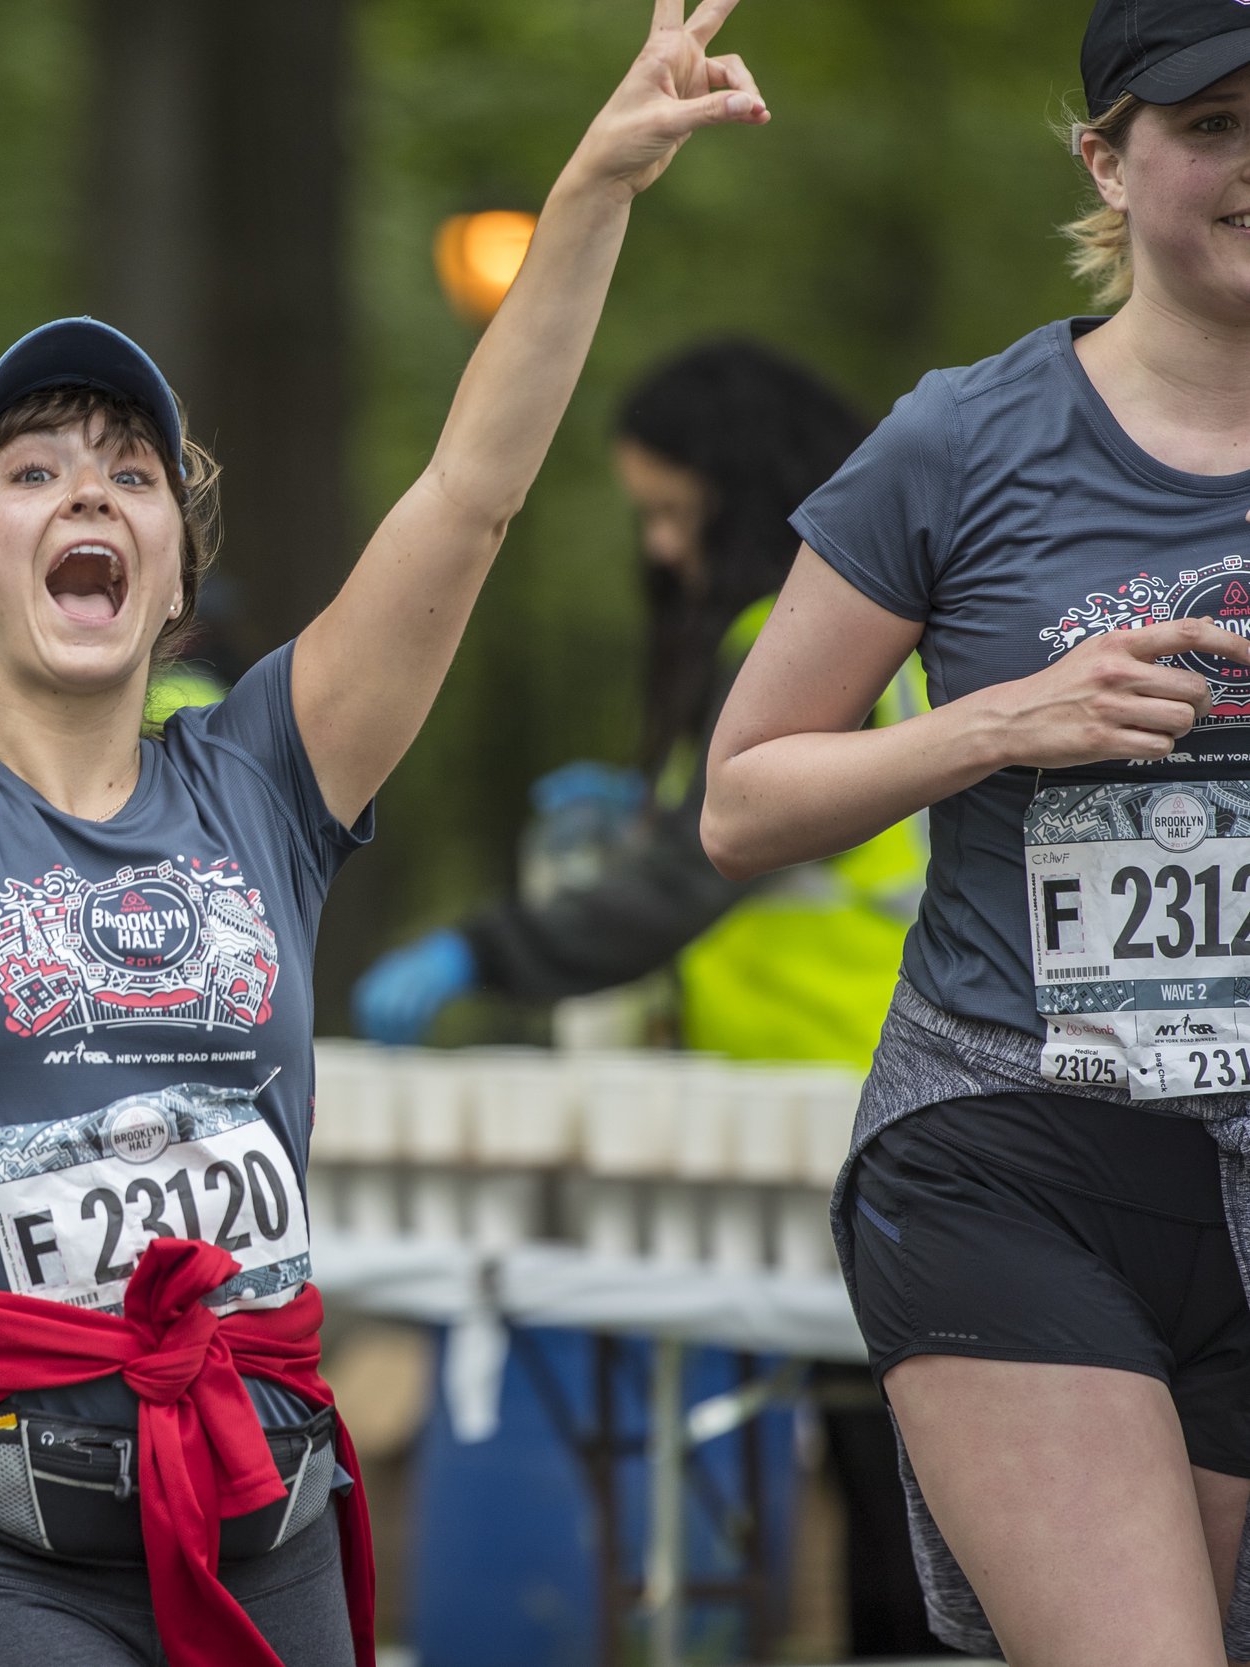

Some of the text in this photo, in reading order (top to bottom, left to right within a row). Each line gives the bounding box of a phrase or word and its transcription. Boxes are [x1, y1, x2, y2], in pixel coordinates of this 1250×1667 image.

[1199, 754, 1224, 762] NEW
[1227, 753, 1250, 761] YOR
[1155, 816, 1203, 827] BROOKLYN
[1167, 827, 1191, 838] HALF
[92, 908, 189, 931] BROOKLYN
[1043, 879, 1080, 950] F
[118, 929, 165, 949] HALF
[125, 955, 162, 967] 2017
[1161, 983, 1207, 1001] WAVE 2
[1083, 1023, 1115, 1036] airbnb
[116, 1054, 142, 1064] NEW
[145, 1054, 175, 1063] YORK
[178, 1053, 208, 1062] ROAD
[211, 1050, 256, 1061] RUNNERS
[1074, 1048, 1099, 1056] Medical
[1055, 1054, 1117, 1084] 23125
[1189, 1048, 1250, 1088] 231
[1158, 1069, 1167, 1092] Check
[114, 1125, 165, 1144] BROOKLYN
[128, 1139, 153, 1152] HALF
[13, 1209, 59, 1286] F
[81, 1150, 289, 1285] 23120
